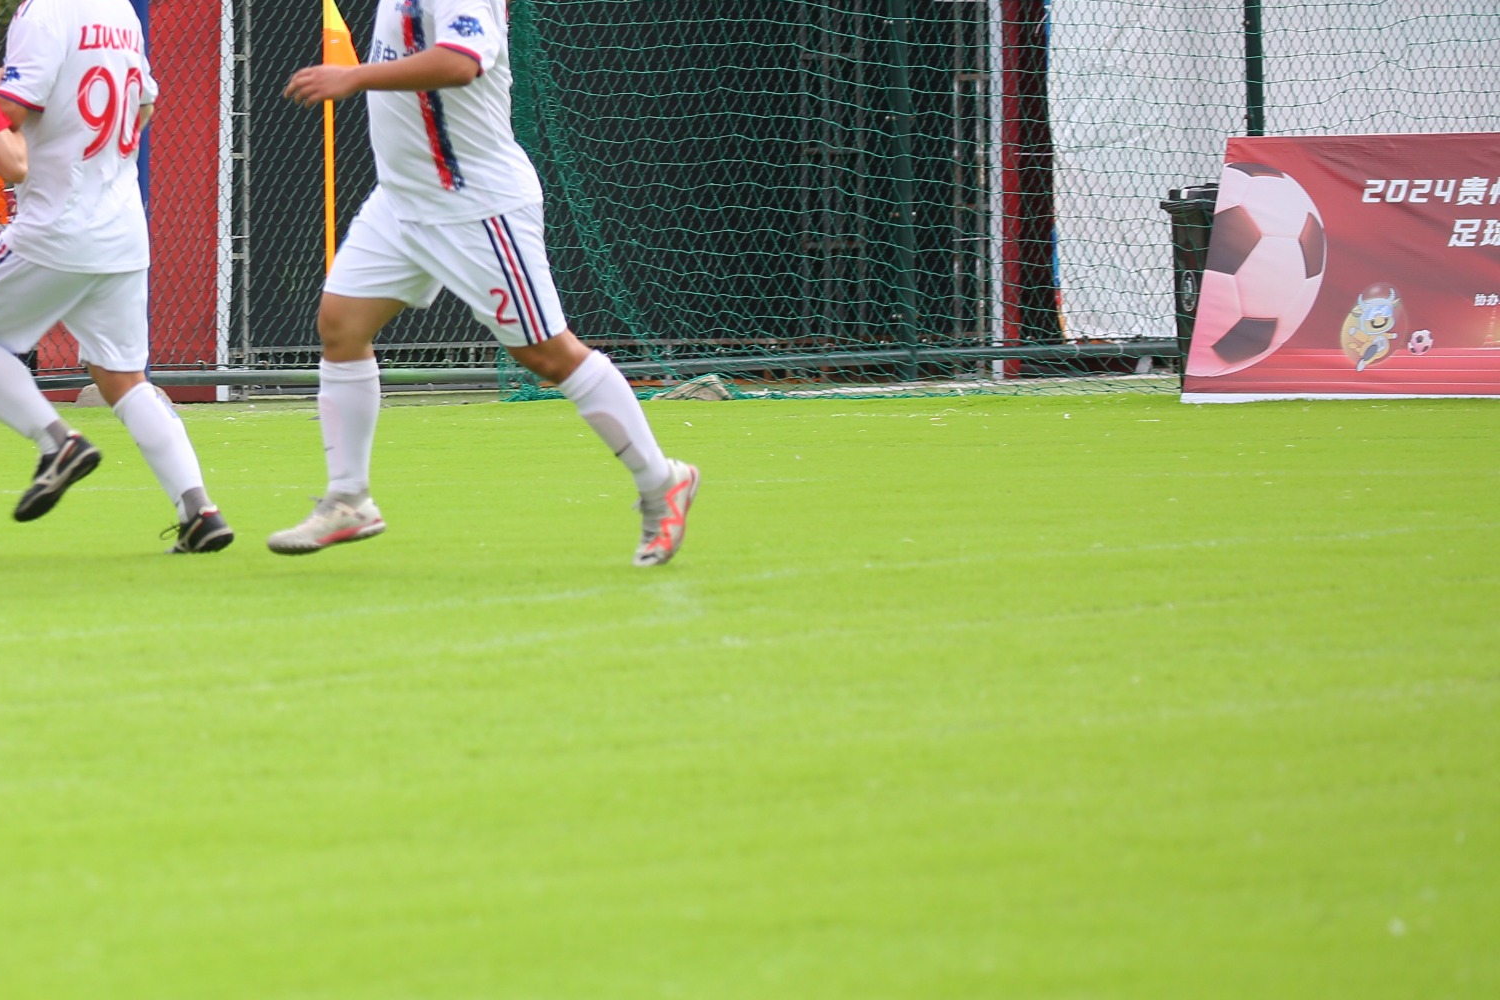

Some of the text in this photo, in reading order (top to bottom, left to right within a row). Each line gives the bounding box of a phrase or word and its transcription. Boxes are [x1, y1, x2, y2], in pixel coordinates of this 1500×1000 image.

[77, 65, 144, 162] 90
[489, 287, 519, 326] 2
[1474, 293, 1500, 307] 协办
